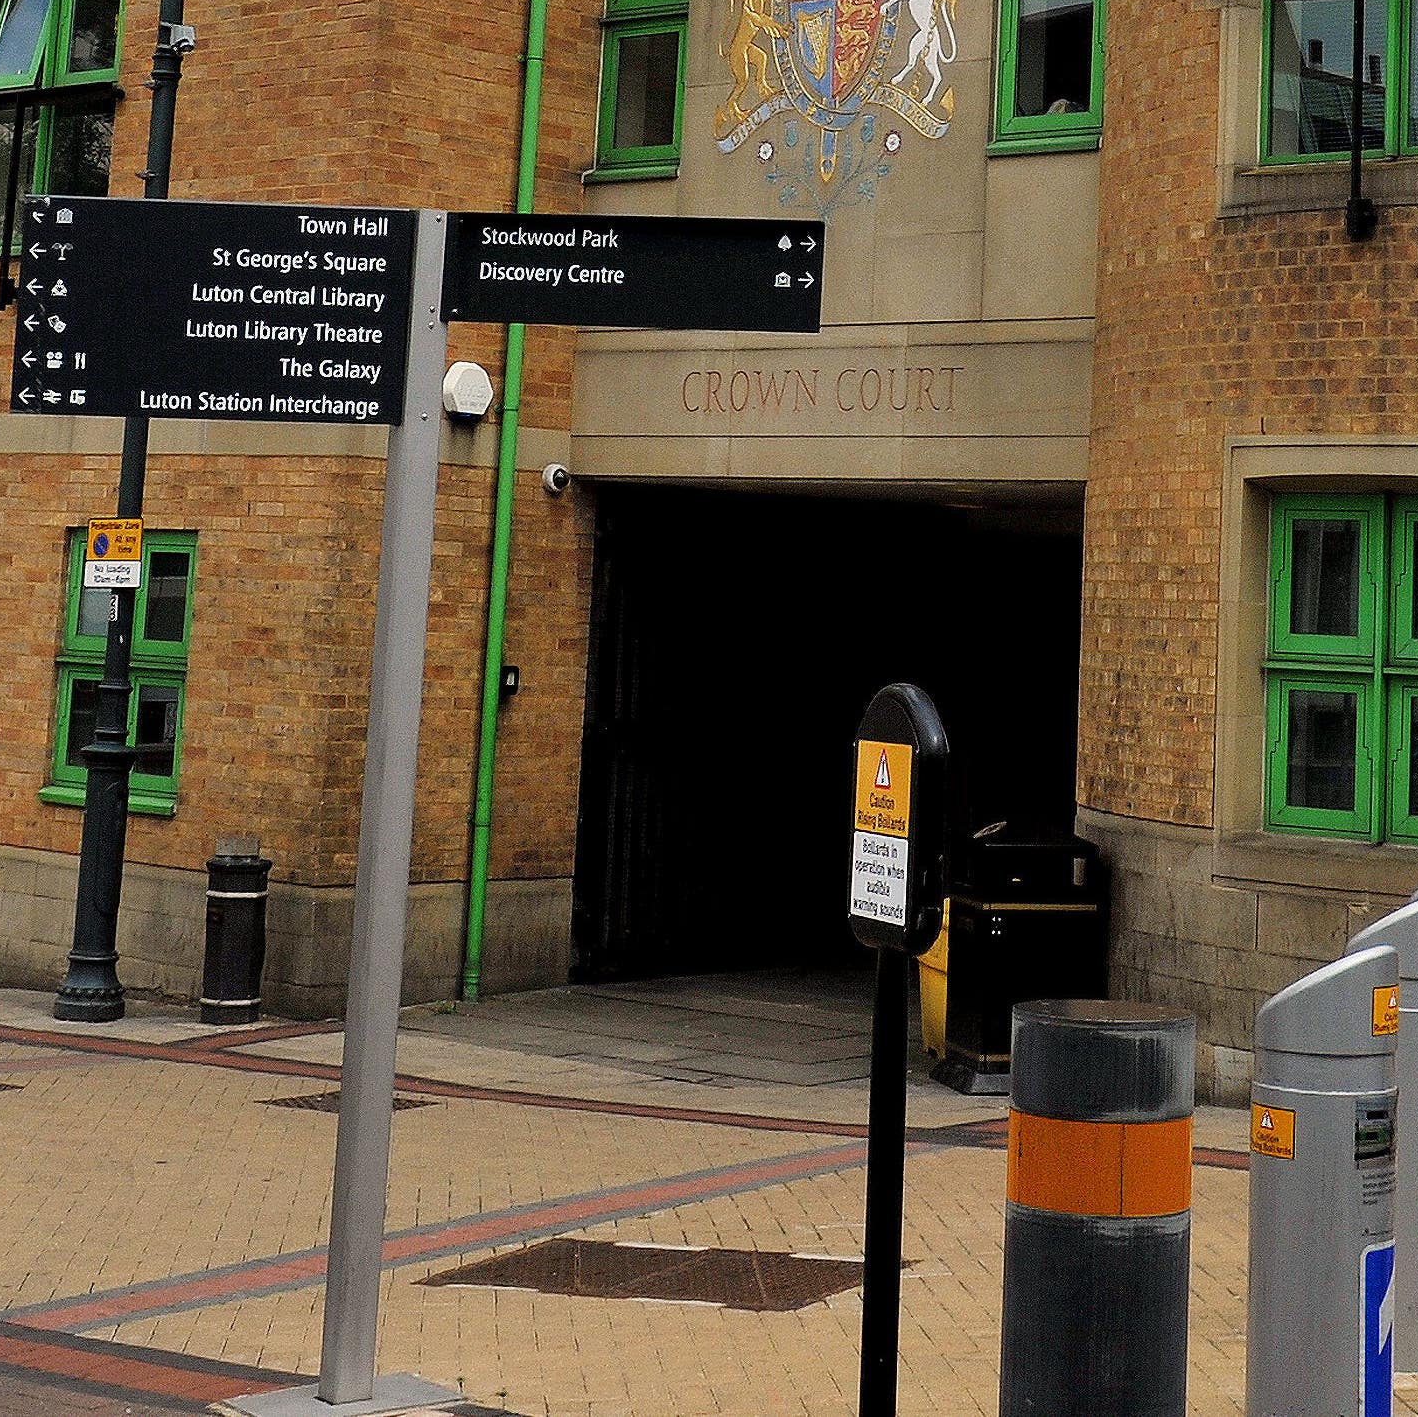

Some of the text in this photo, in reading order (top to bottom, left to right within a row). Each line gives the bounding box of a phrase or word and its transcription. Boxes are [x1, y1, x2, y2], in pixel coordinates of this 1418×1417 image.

[298, 215, 389, 237] Town Hall
[481, 226, 619, 249] Stockwood Park
[212, 247, 387, 275] St George's Square
[479, 261, 625, 287] Discovery Centre
[191, 282, 386, 313] Luton Central Library
[186, 318, 383, 346] Luton Library Theatre
[279, 357, 382, 385] The Galaxy
[140, 389, 380, 420] Luton Station Interchange
[682, 367, 965, 414] CROWN COURT
[869, 792, 896, 811] Caution
[857, 809, 906, 832] Rising Bollards
